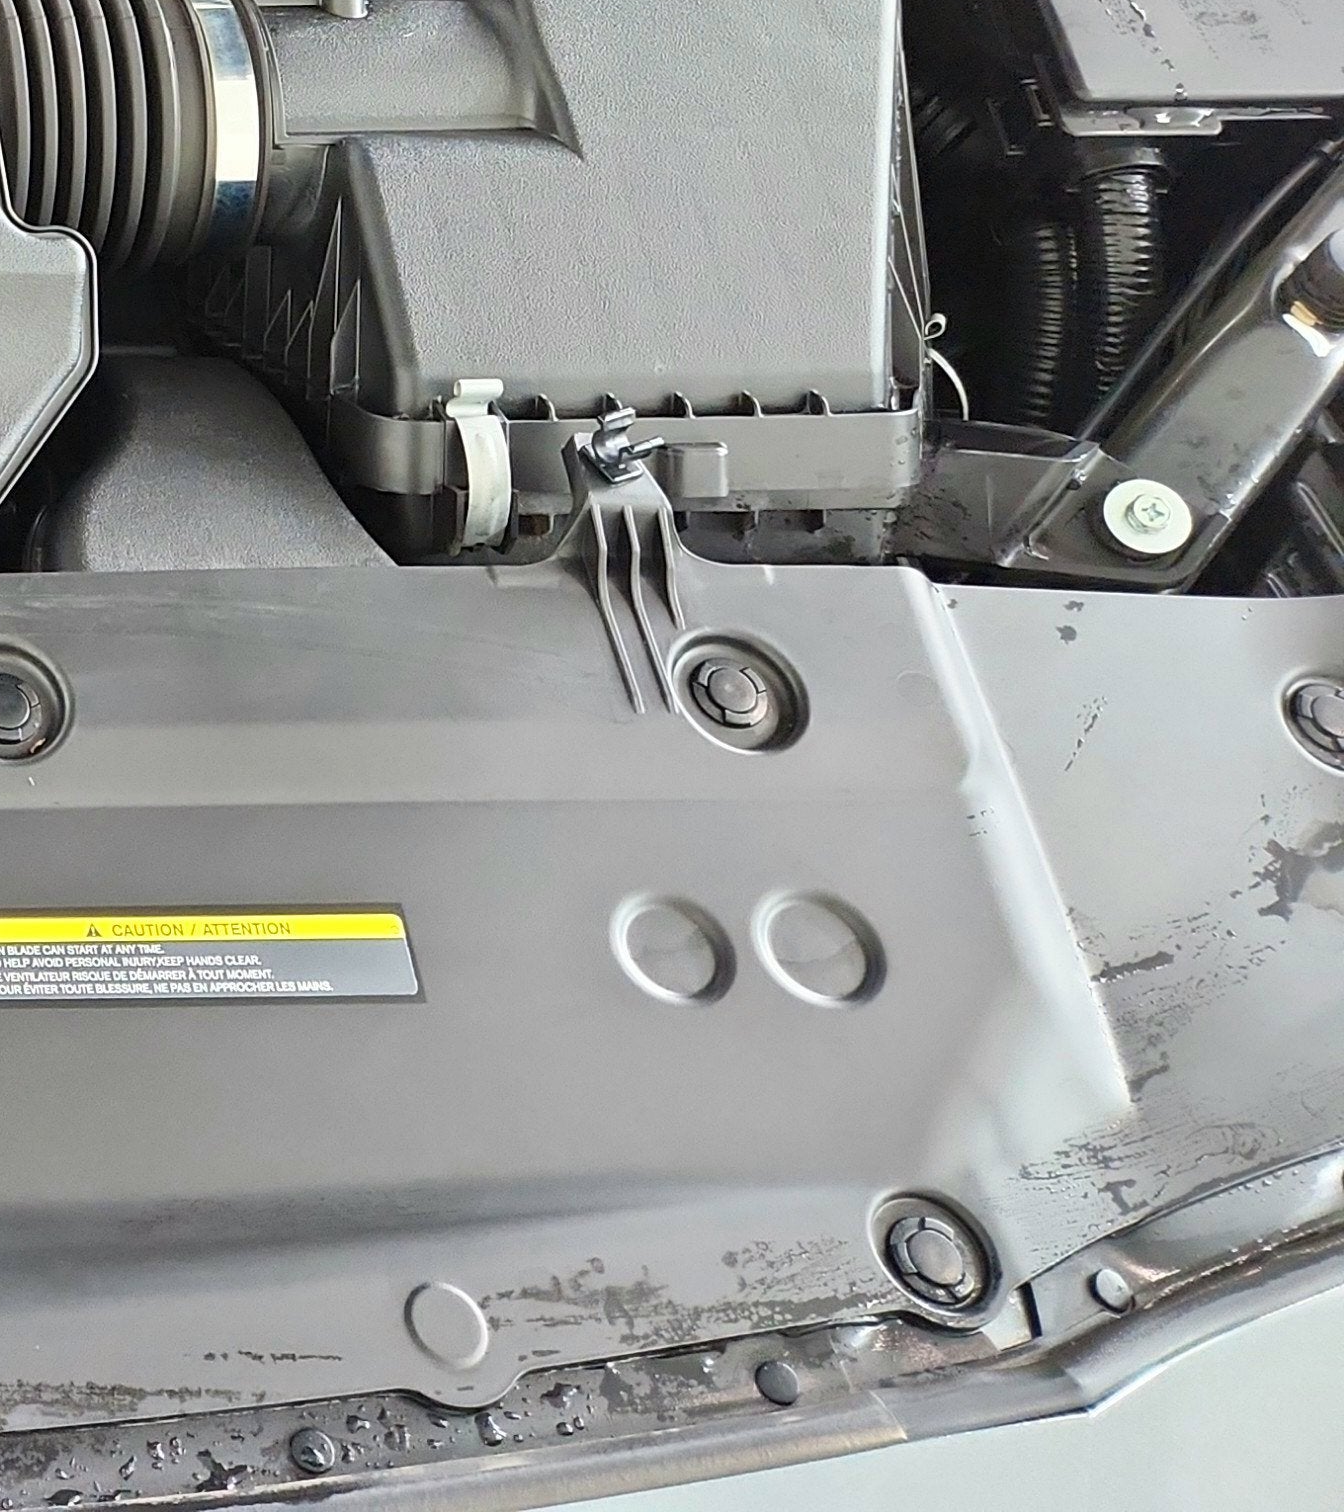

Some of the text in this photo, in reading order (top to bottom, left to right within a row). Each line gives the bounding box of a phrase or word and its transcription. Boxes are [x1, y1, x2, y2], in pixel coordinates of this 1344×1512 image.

[112, 923, 184, 936] CAUTION
[203, 922, 291, 935] ATTENTION
[7, 945, 41, 956] BLADE
[43, 945, 63, 955] CAN
[67, 945, 98, 955] START
[101, 945, 112, 954] AT
[115, 944, 136, 954] ANY
[137, 944, 164, 954] TIME.
[4, 959, 30, 968] HELP
[32, 958, 63, 968] AVOID
[65, 957, 121, 968] PERSONAL
[186, 956, 223, 966] HANDS
[225, 955, 261, 965] CLEAR.
[3, 971, 70, 982] VENTILATEUR
[72, 971, 111, 982] RISQUE
[113, 971, 128, 981] DE
[130, 968, 186, 981] DÉMARRER
[188, 967, 196, 980] À
[197, 969, 224, 980] TOUT
[226, 969, 274, 980] MOMENT.
[24, 982, 58, 995] ÉVITER
[60, 984, 93, 994] TOUTE
[95, 983, 153, 995] BLESSURE,
[154, 983, 170, 993] NE
[172, 983, 191, 993] PAS
[193, 983, 208, 992] EN
[210, 981, 275, 993] APPROCHER
[276, 981, 296, 992] LES
[298, 980, 333, 992] MAINS.
